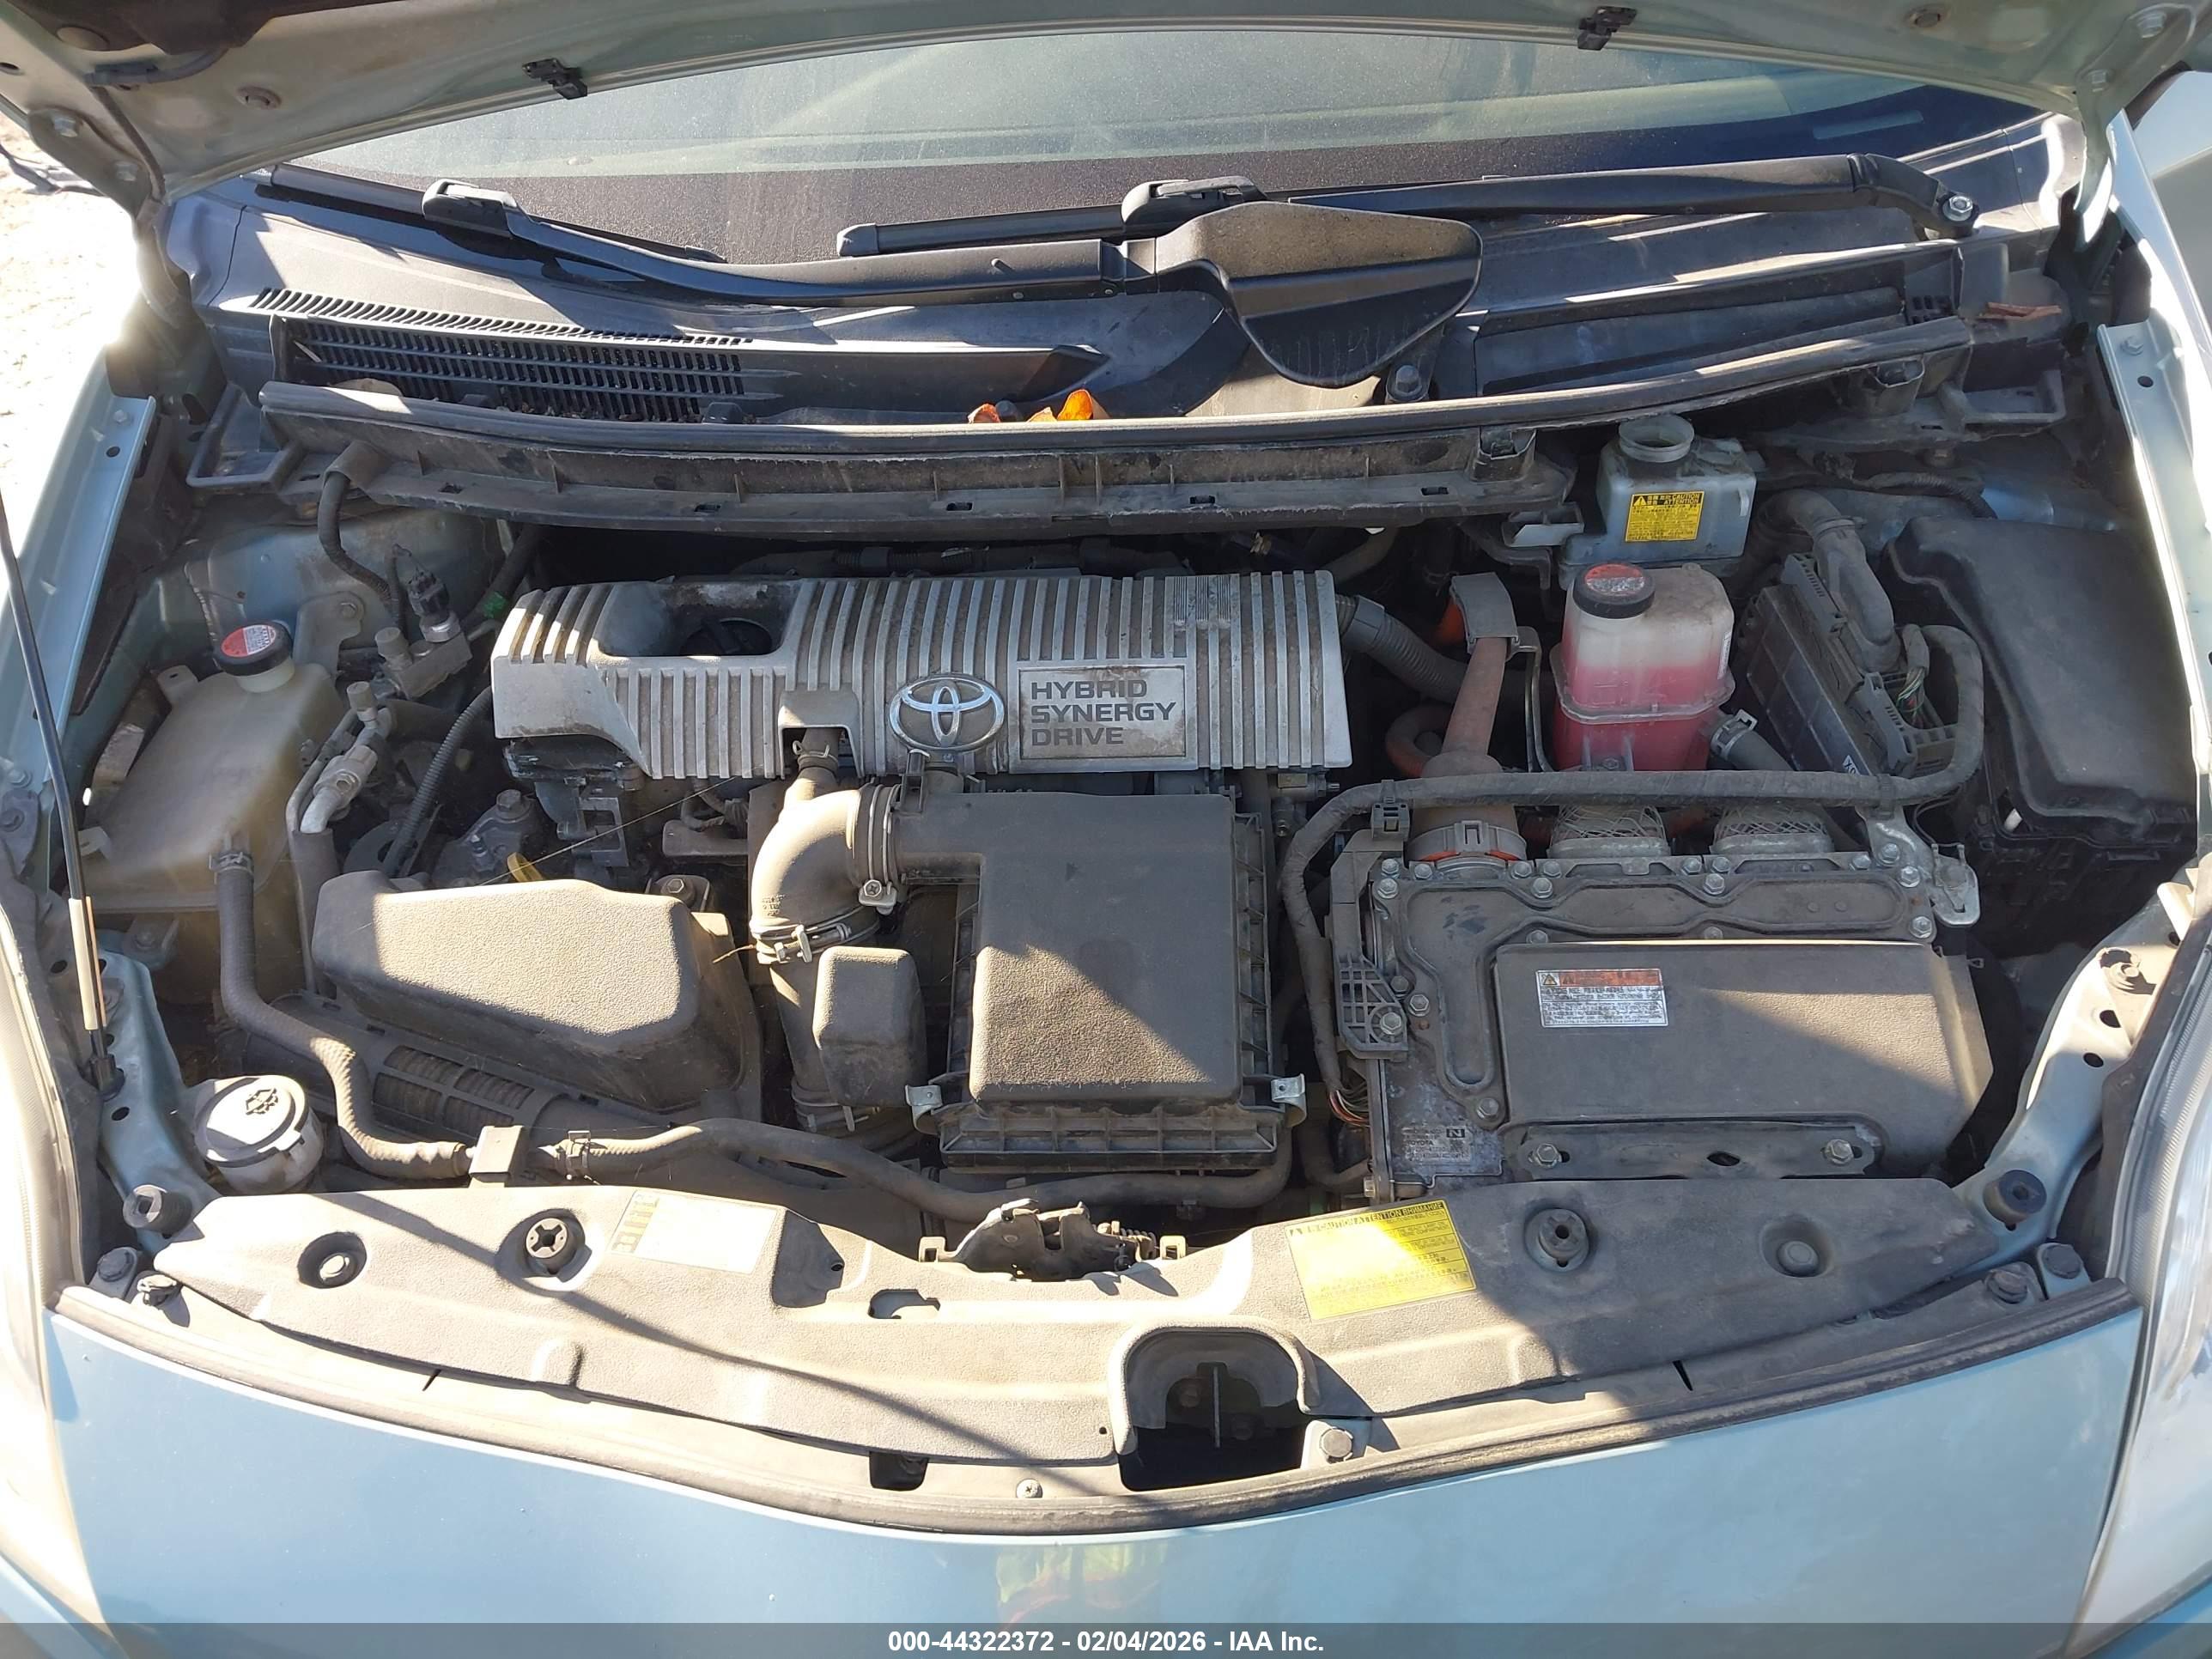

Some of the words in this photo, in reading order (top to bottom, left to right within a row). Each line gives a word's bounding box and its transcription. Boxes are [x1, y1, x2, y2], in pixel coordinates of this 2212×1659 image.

[1030, 680, 1147, 700] HYBRID
[1030, 702, 1176, 724] SYNERGY
[1031, 727, 1124, 746] DRIVE
[1354, 1209, 1402, 1224] ATTENTION
